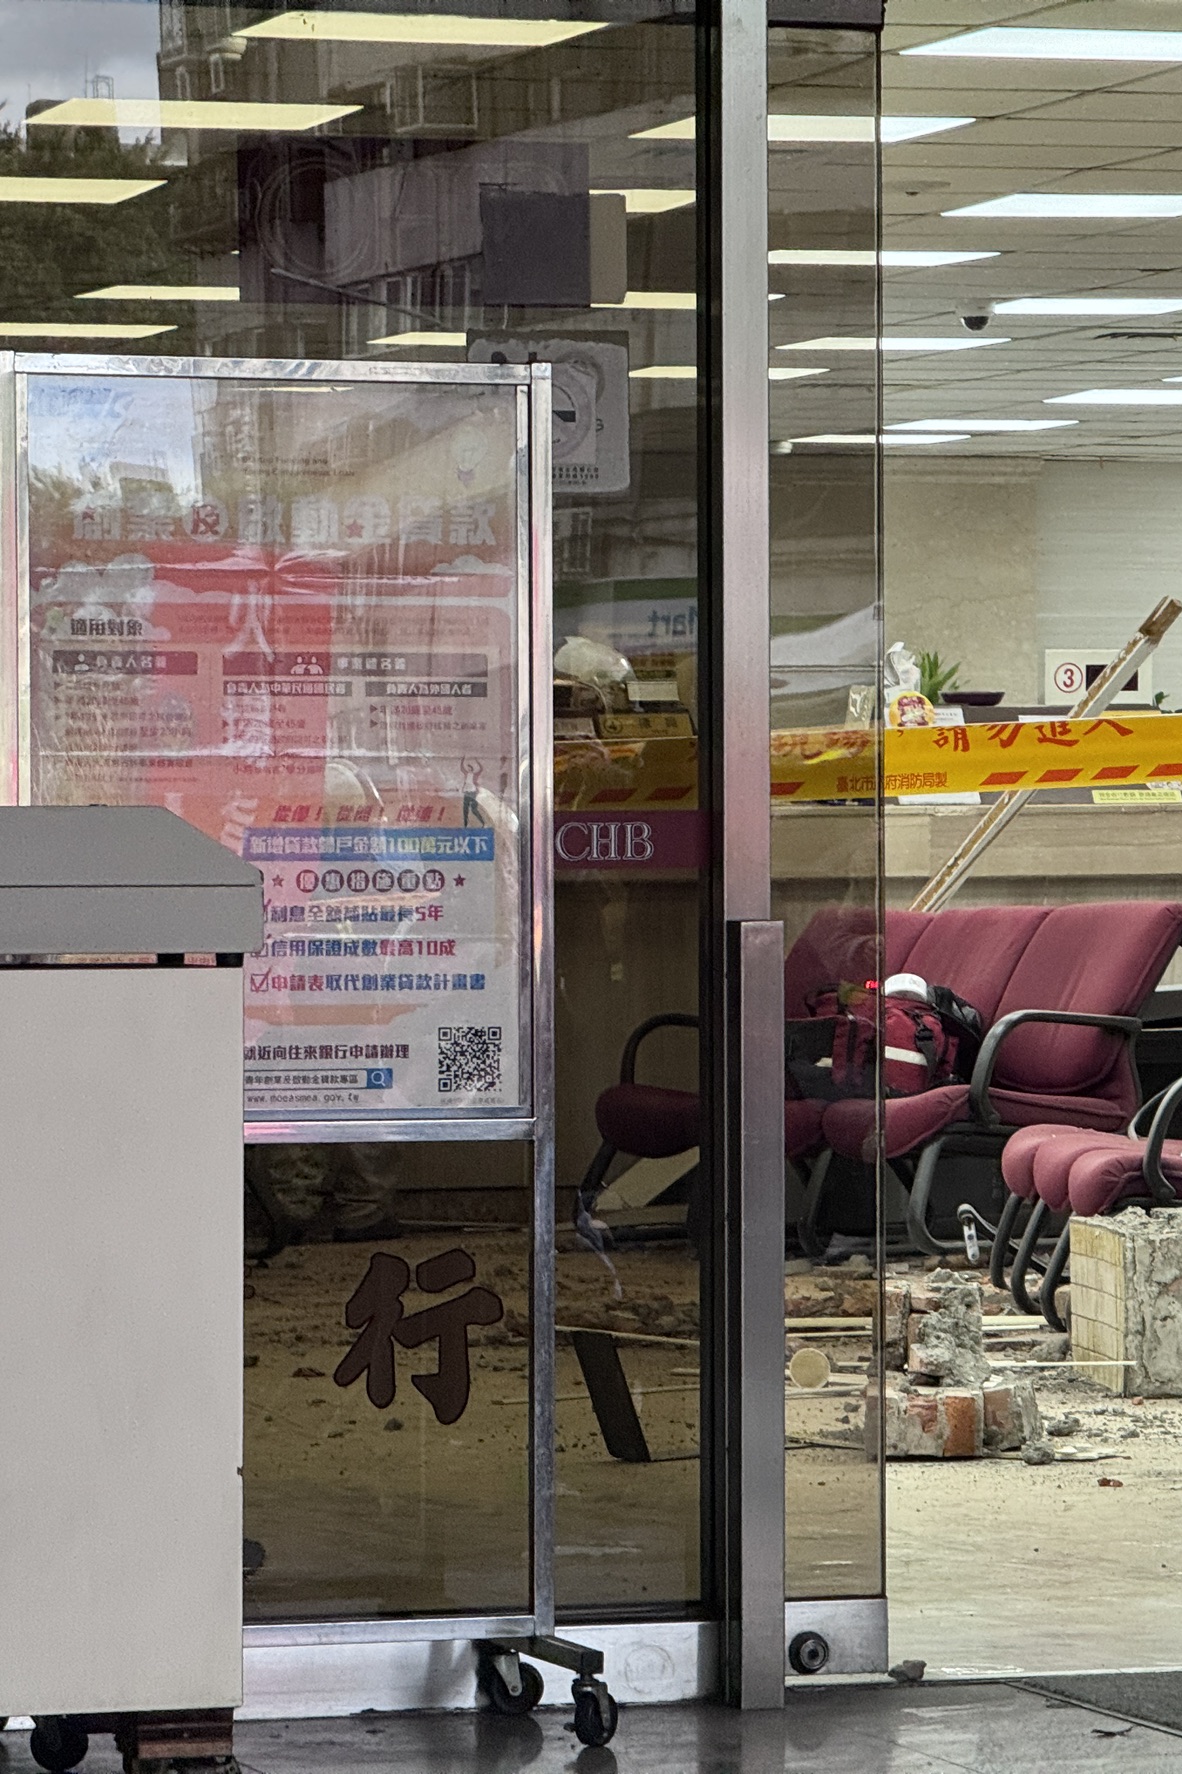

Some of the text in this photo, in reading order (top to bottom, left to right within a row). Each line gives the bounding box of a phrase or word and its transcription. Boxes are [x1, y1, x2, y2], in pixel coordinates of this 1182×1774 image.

[70, 618, 144, 637] 適用對象
[554, 820, 655, 862] CHB
[270, 905, 445, 923] 利息全額補貼最長5年
[271, 939, 457, 957] 信用保證成數最高10成
[271, 973, 486, 991] 申請表取代創業貸款計畫書
[332, 1248, 504, 1426] 行
